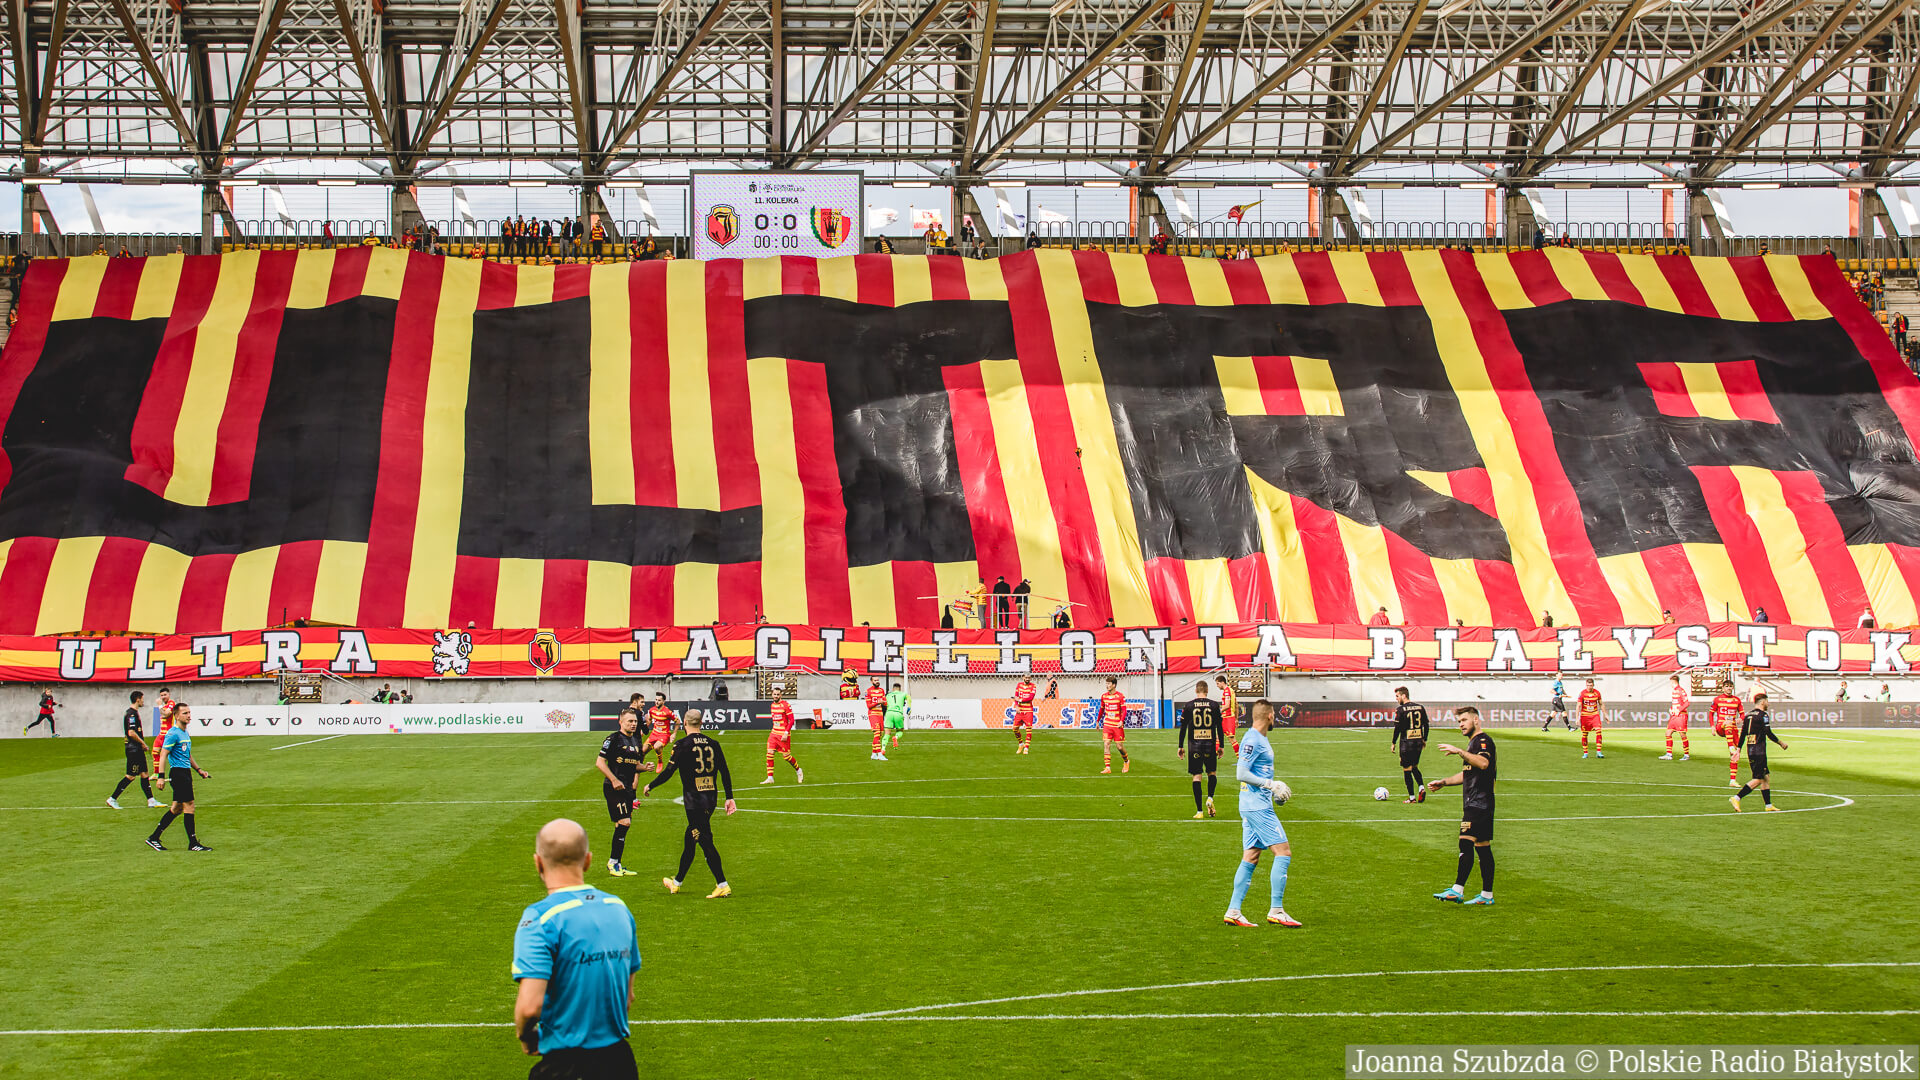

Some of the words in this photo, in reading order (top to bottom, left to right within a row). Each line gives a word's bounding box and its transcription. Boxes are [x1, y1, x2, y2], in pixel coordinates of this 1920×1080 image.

[0, 293, 1920, 562] ULTRA
[57, 630, 377, 680] ULTRA
[620, 625, 1297, 673] JAGIELLONIA
[1368, 624, 1914, 671] BIAŁYSTOK
[1240, 668, 1250, 676] 20
[198, 717, 303, 727] VOLVO
[318, 717, 350, 726] NORD
[353, 716, 382, 726] AUTO
[403, 713, 523, 727] www.podlaskie.eu
[699, 708, 751, 723] ASTA
[1060, 703, 1096, 727] STS
[1193, 708, 1212, 727] 66
[1406, 711, 1421, 729] 13
[692, 746, 715, 773] 33
[617, 802, 628, 814] 11
